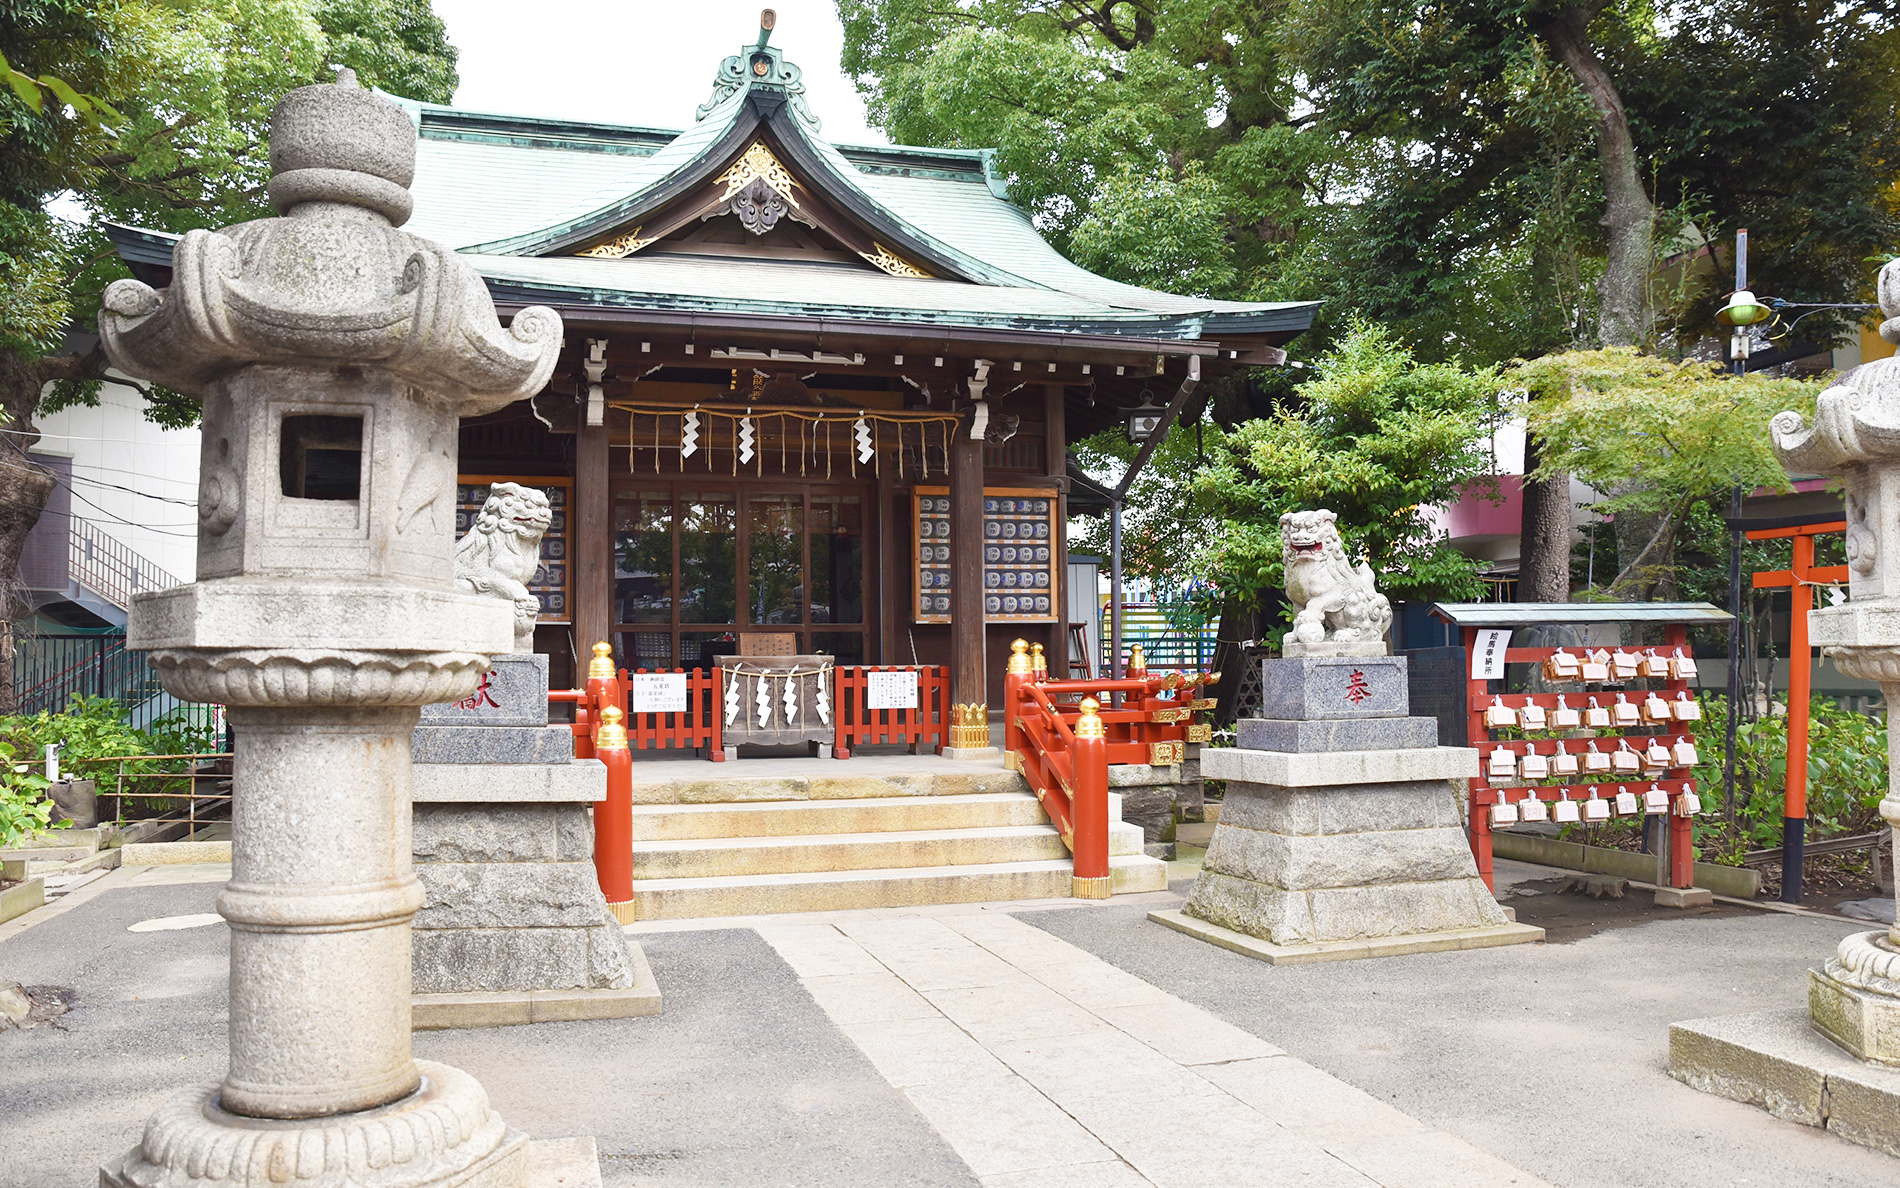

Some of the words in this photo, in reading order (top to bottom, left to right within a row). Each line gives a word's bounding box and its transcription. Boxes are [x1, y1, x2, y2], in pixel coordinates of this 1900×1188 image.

[1484, 631, 1499, 675] 絵馬奉納所
[1343, 668, 1373, 707] 奉
